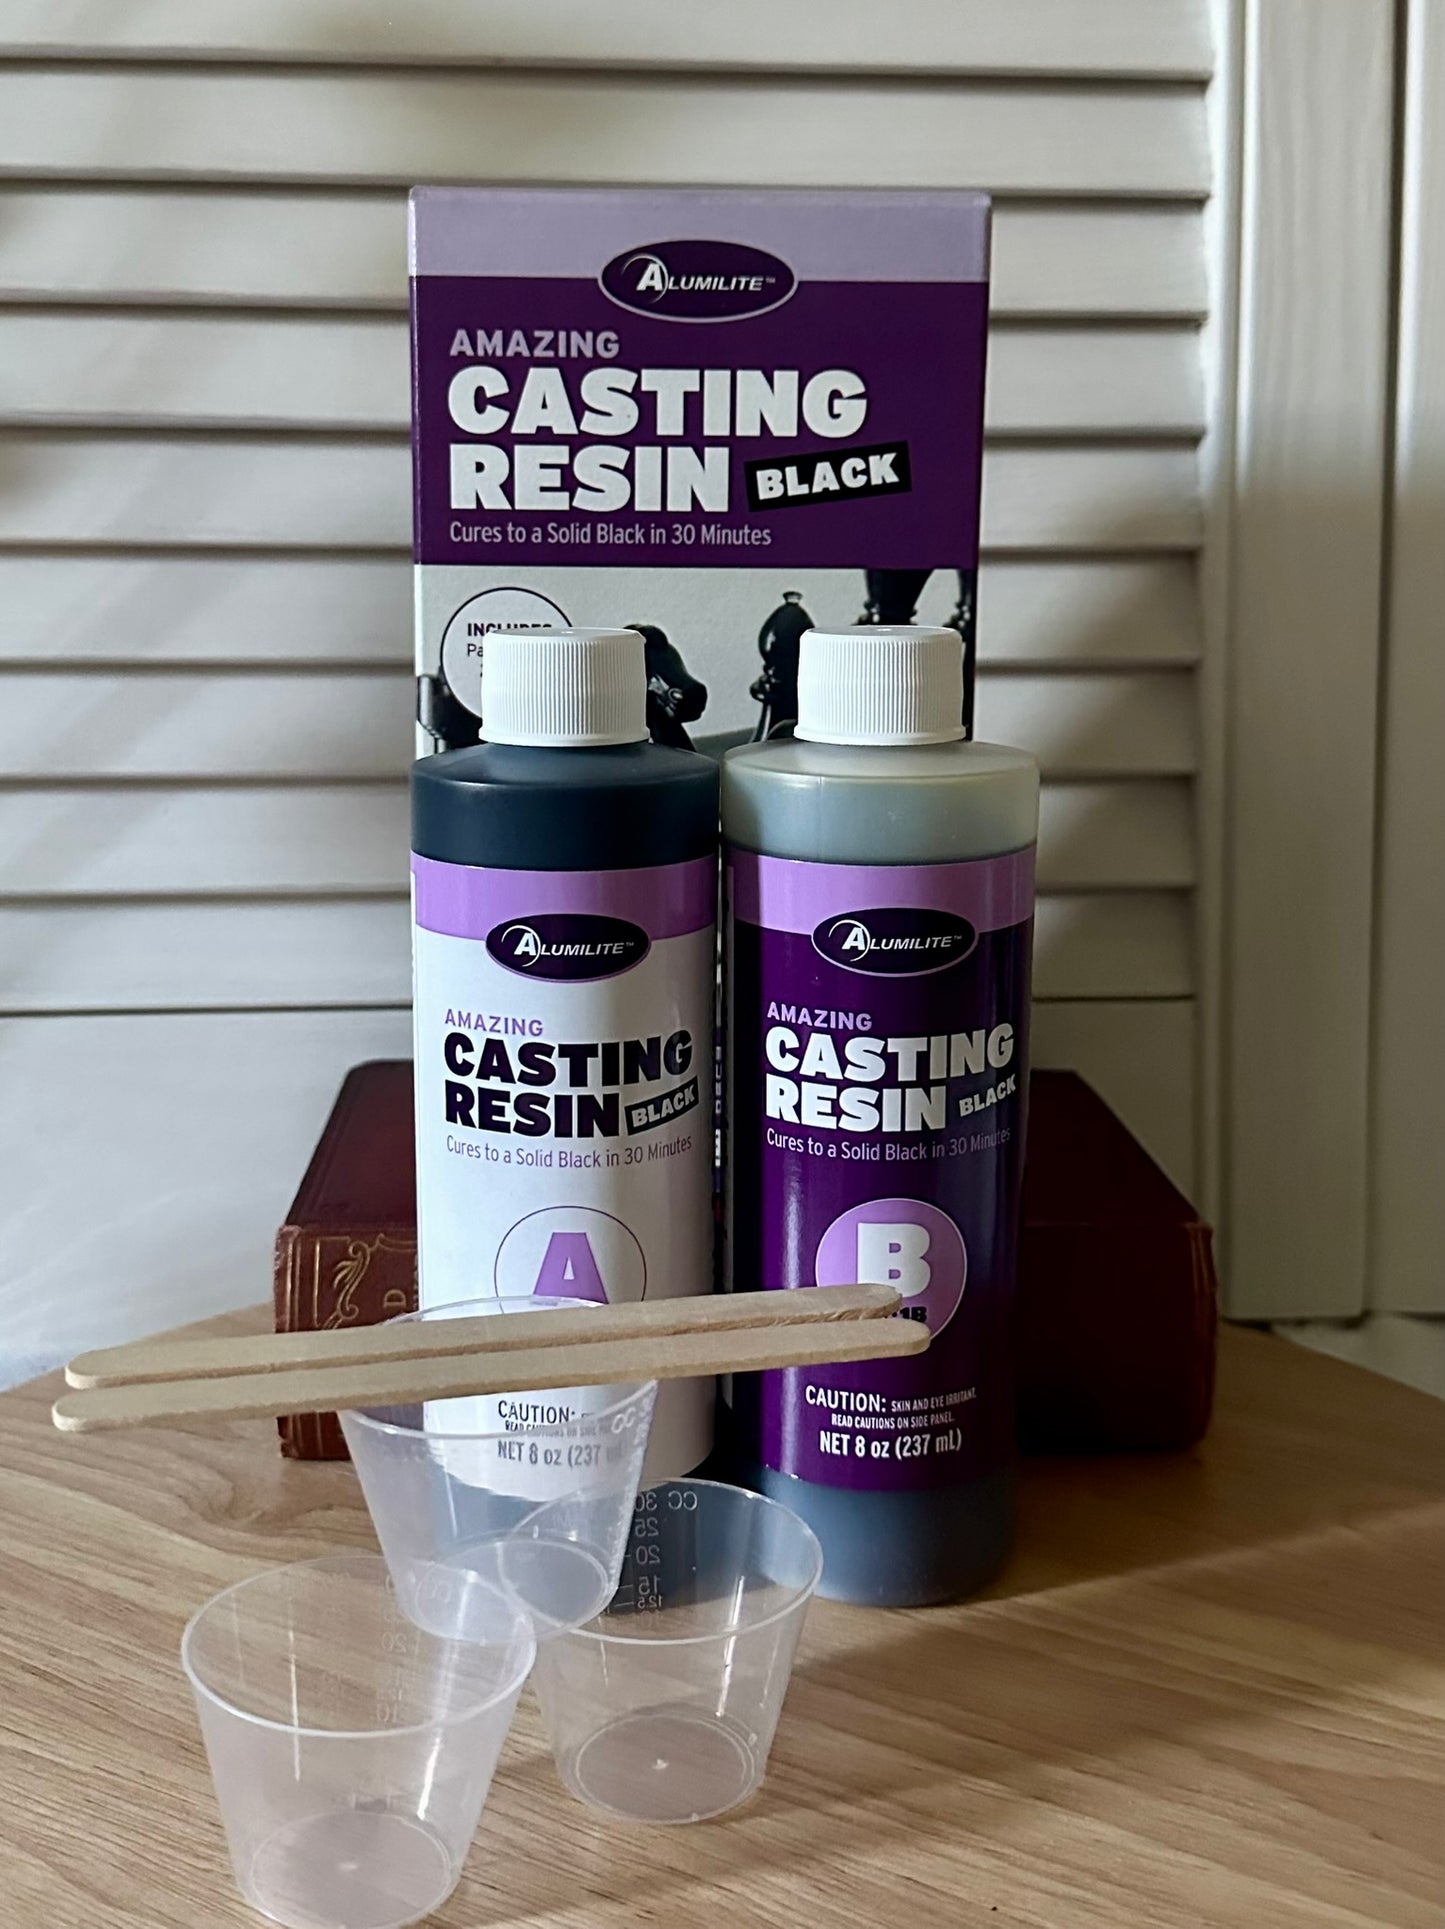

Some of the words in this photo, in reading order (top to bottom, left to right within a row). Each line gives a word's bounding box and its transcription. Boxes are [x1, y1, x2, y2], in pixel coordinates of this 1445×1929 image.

[449, 329, 620, 359] AMAZING
[447, 364, 868, 438] CASTING
[449, 443, 729, 513] RESIN
[755, 451, 900, 501] BLACK
[449, 521, 502, 543] Cures
[507, 522, 526, 543] to
[531, 527, 542, 543] a
[547, 522, 591, 544] Solid
[596, 523, 645, 545] Black
[650, 523, 666, 545] in
[671, 524, 696, 545] 30
[701, 524, 772, 546] Minutes
[444, 1008, 544, 1037] AMAZING
[765, 1001, 873, 1031] AMAZING
[443, 1029, 693, 1088] CASTING
[764, 1022, 1015, 1082] CASTING
[444, 1079, 620, 1139] RESIN
[630, 1084, 696, 1129] BLACK
[764, 1073, 946, 1133] RESIN
[957, 1073, 1017, 1118] BLACK
[446, 1134, 481, 1159] Cures
[484, 1143, 500, 1162] to
[503, 1150, 512, 1164] a
[516, 1148, 553, 1168] Solid
[558, 1150, 601, 1169] Black
[606, 1150, 620, 1168] in
[624, 1148, 644, 1166] 30
[647, 1135, 693, 1161] Minutes
[765, 1127, 804, 1153] Cures
[807, 1137, 824, 1156] to
[827, 1143, 837, 1158] a
[841, 1141, 880, 1161] Solid
[885, 1142, 928, 1161] Black
[931, 1141, 945, 1158] in
[949, 1138, 967, 1156] 30
[970, 1127, 1011, 1153] Minutes
[532, 1231, 609, 1304] A
[857, 1222, 931, 1298] B
[805, 1384, 887, 1413] CAUTION:
[891, 1399, 911, 1413] SKIN
[912, 1398, 929, 1410] AND
[930, 1396, 945, 1409] EYE
[831, 1413, 853, 1428] READ
[854, 1416, 895, 1430] CAUTIONS
[897, 1416, 909, 1429] ON
[911, 1415, 928, 1428] SIDE
[497, 1440, 525, 1462] NET
[529, 1442, 539, 1465] 8
[543, 1448, 563, 1465] oz
[568, 1444, 602, 1470] (237
[820, 1430, 851, 1457] NET
[855, 1435, 866, 1458] 8
[871, 1441, 890, 1458] oz
[895, 1433, 931, 1461] (237
[936, 1428, 962, 1453] mL)
